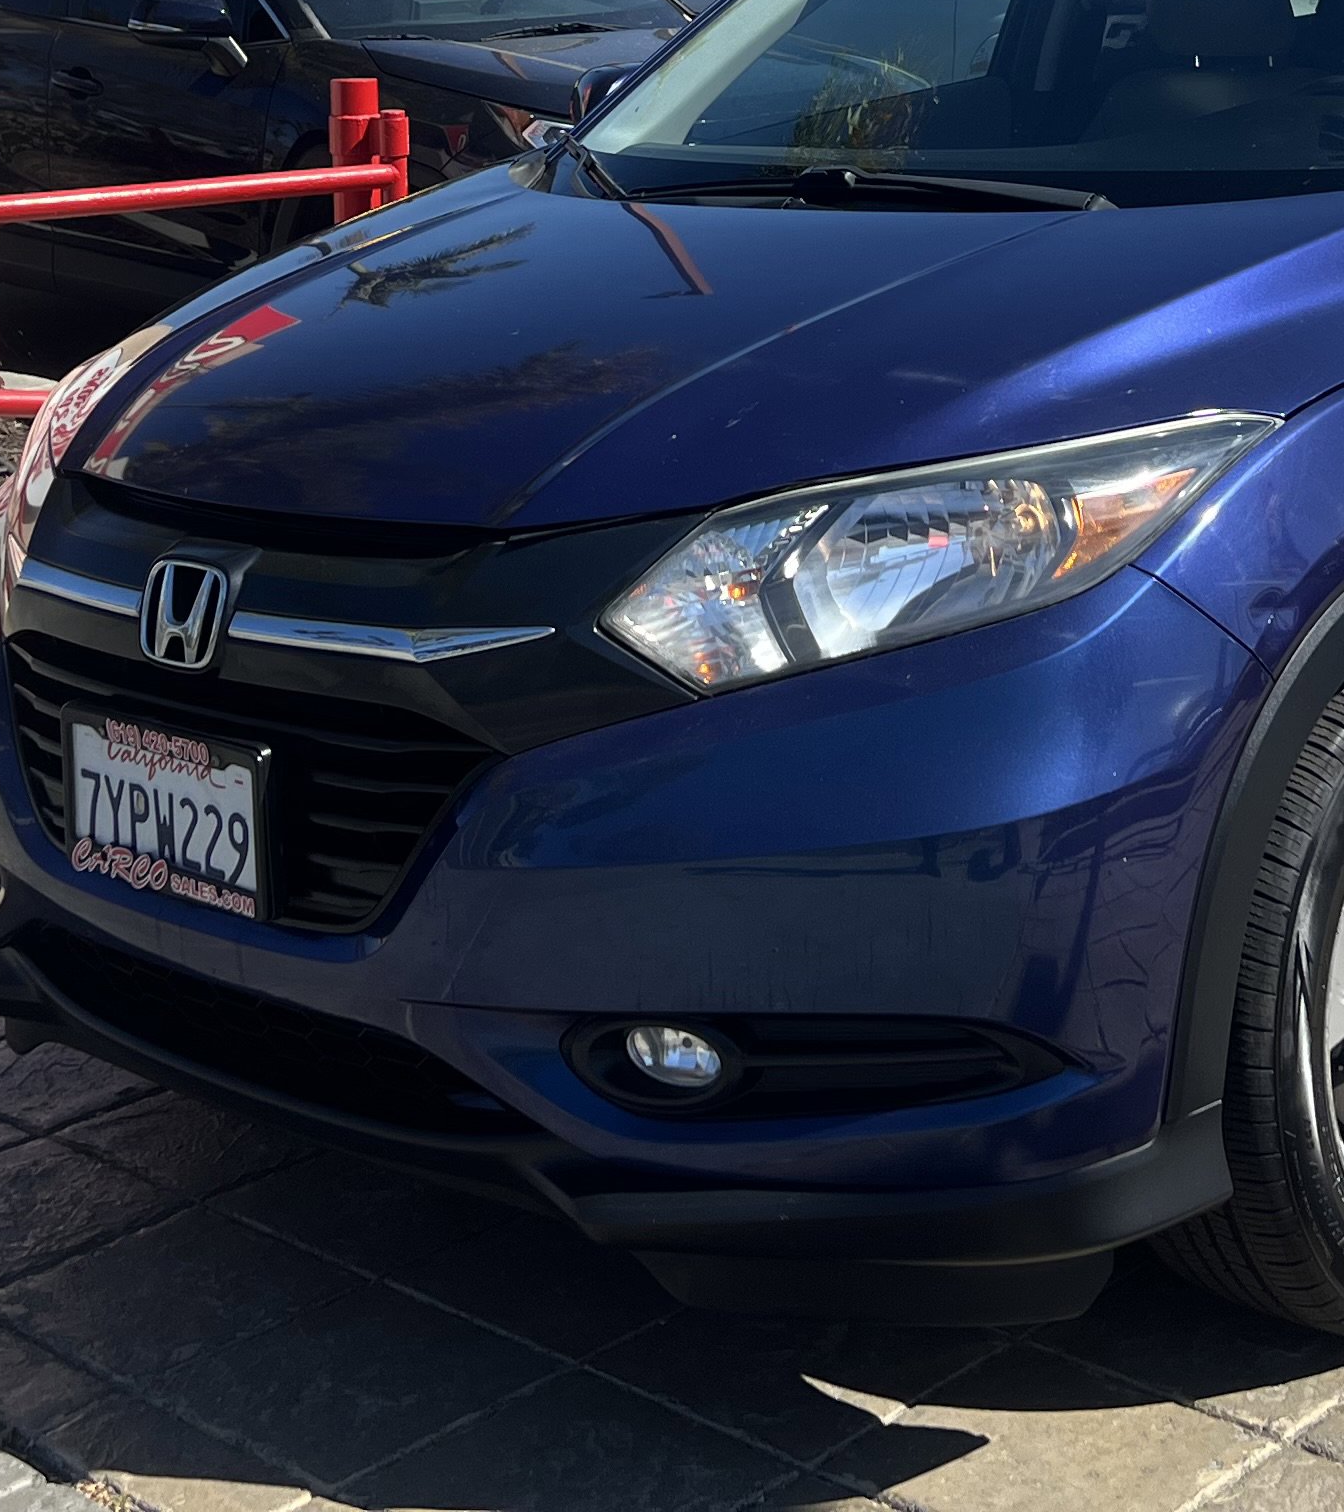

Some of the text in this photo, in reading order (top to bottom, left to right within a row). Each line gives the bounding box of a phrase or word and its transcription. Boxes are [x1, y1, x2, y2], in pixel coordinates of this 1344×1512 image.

[105, 717, 210, 766] (619) 420-5700
[81, 768, 249, 885] 7YPW229
[71, 837, 256, 919] CARCO SALES.COM
